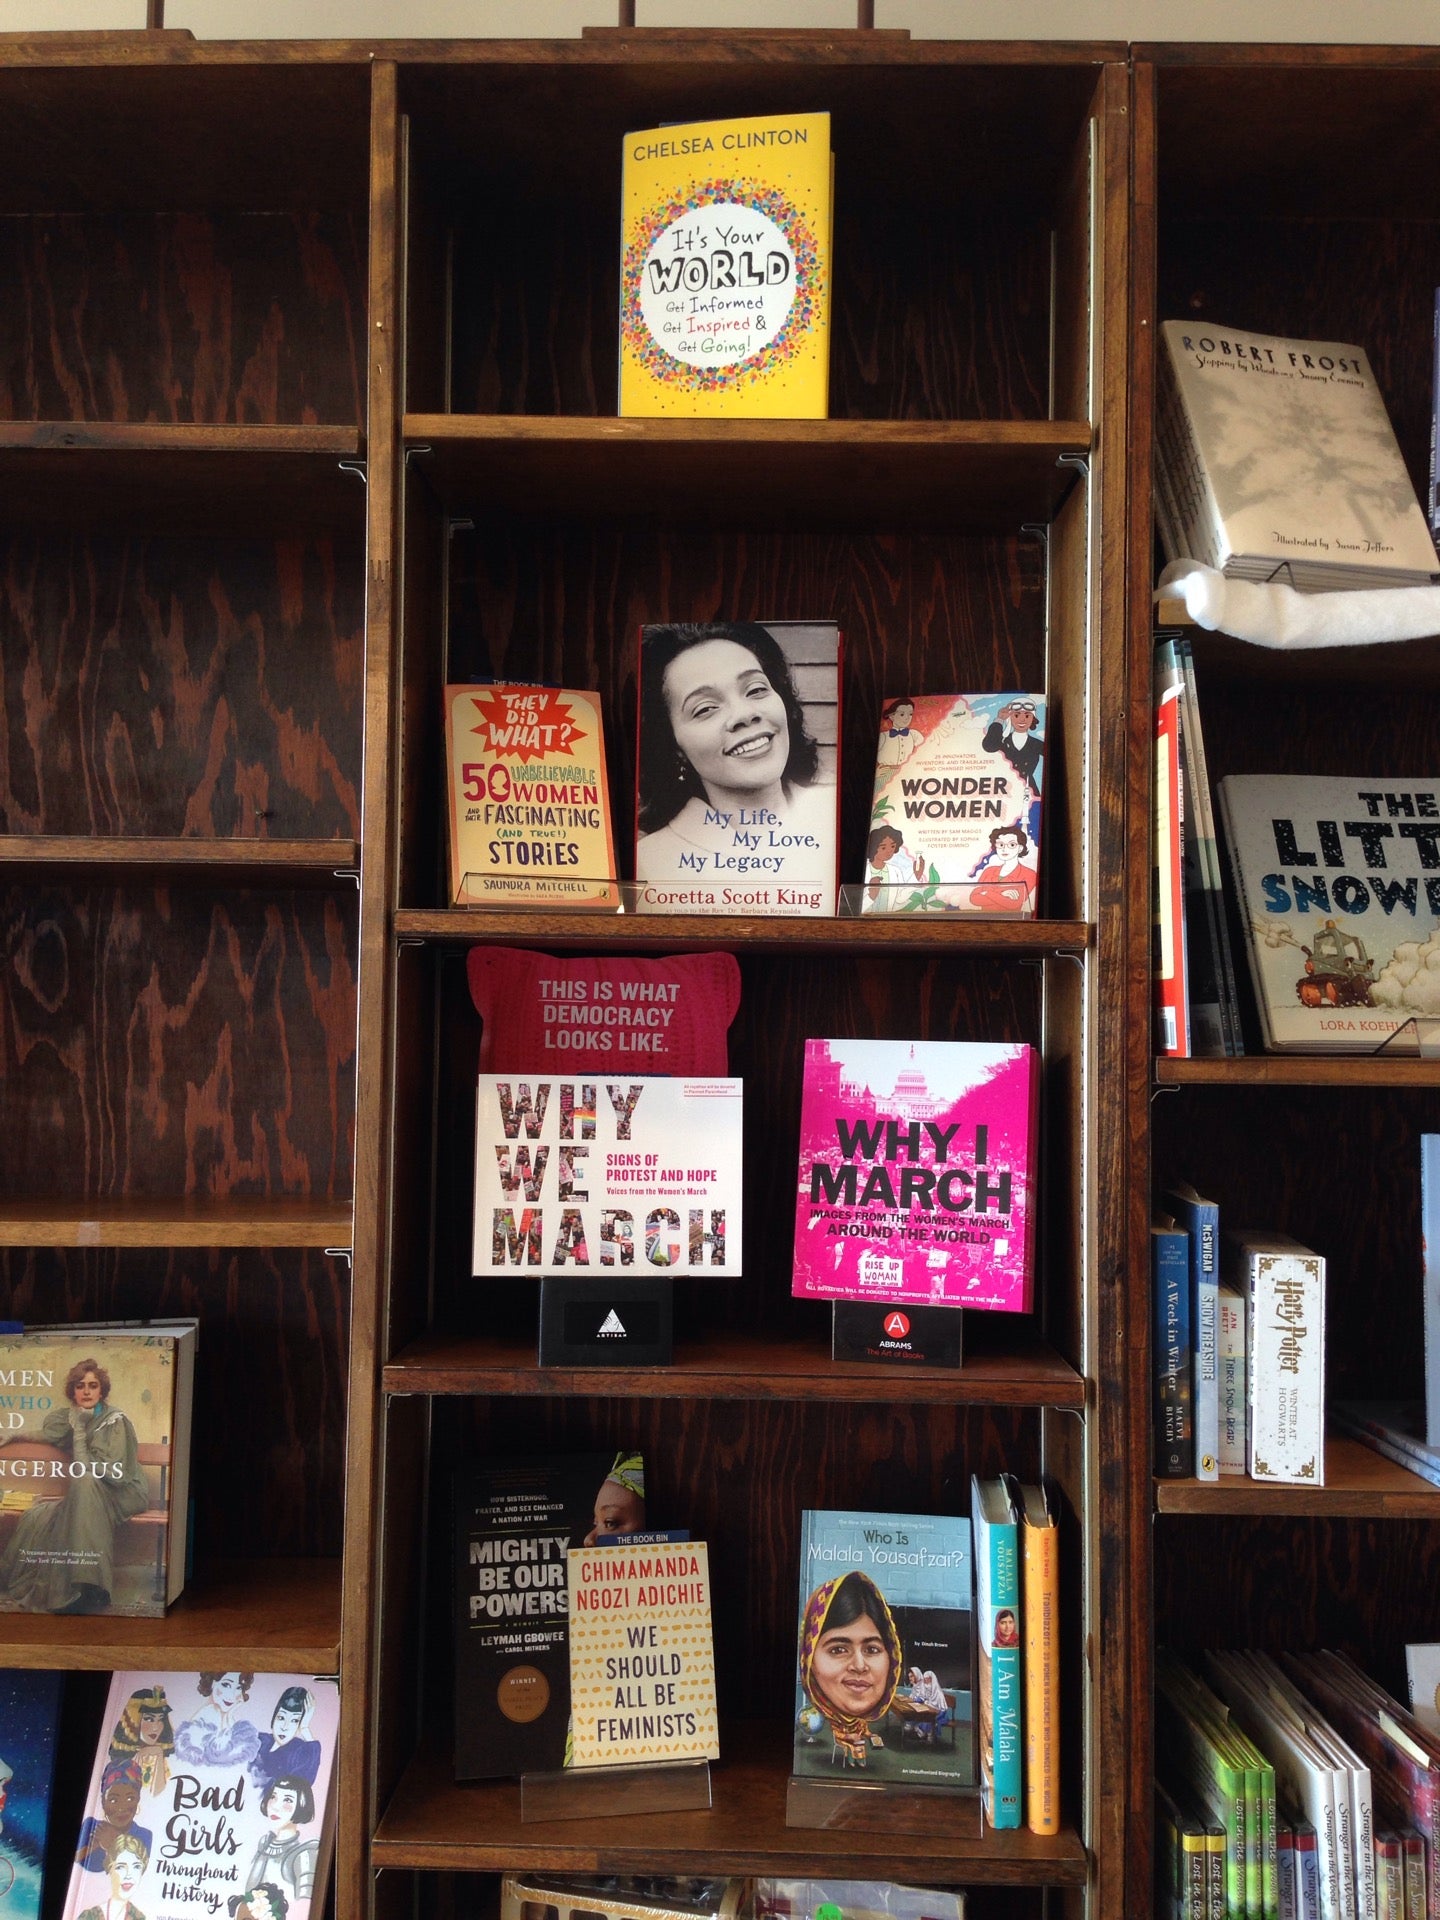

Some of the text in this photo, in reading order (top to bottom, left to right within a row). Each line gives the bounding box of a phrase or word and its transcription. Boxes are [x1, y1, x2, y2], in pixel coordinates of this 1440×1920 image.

[633, 128, 808, 161] CHELSEA CLINTON
[672, 225, 764, 252] It's Your
[648, 250, 790, 294] WORLD
[666, 296, 764, 313] Get Informed
[663, 315, 767, 336] Get Inspired &
[678, 337, 751, 358] Get Going!
[1182, 336, 1362, 375] ROBERT FROST
[501, 693, 549, 711] THEY
[489, 722, 572, 749] WHAT?
[462, 763, 511, 803] 50
[512, 783, 598, 805] WOMEN
[901, 777, 1008, 796] WONDER
[903, 800, 1002, 819] WOMEN
[1358, 792, 1440, 818] THE
[704, 808, 783, 829] My Life,
[732, 830, 821, 850] My Love,
[678, 852, 785, 873] My Legacy
[483, 880, 531, 891] SAUNDRA
[644, 888, 823, 909] Coretta Scott King
[539, 980, 681, 1002] THIS IS WHAT
[543, 1005, 674, 1027] DEMOCRACY
[1320, 1020, 1356, 1031] LORA
[545, 1030, 669, 1052] LOOKS LIKE.
[496, 1083, 645, 1140] WHY
[836, 1119, 988, 1165] WHY I
[606, 1154, 659, 1166] SIGNS OF
[494, 1145, 590, 1202] WE
[606, 1169, 717, 1181] PROTEST AND HOPE
[606, 1187, 628, 1195] Voices
[629, 1187, 645, 1195] from
[657, 1187, 686, 1195] Women's
[810, 1163, 1012, 1214] MARCH
[810, 1208, 1010, 1229] IMAGES FROM THE WOMEN'S MARCH
[492, 1208, 726, 1266] MARCH
[826, 1223, 991, 1244] AROUND THE WORLD
[1202, 1224, 1213, 1272] McSWIGAN
[864, 1271, 897, 1281] WOMAN
[865, 1261, 900, 1270] RISE UP
[1167, 1280, 1179, 1392] A Week in Winter
[1201, 1295, 1215, 1380] SNOW TREASURE
[1268, 1278, 1307, 1375] Harry Potter
[879, 1341, 912, 1350] ABRAMS
[1226, 1357, 1236, 1383] THREE
[0, 1396, 53, 1410] WHO
[1226, 1386, 1236, 1414] SNOW
[0, 1412, 25, 1429] D
[1165, 1406, 1174, 1443] BINCHY
[1278, 1387, 1287, 1447] HOGWARTS
[1288, 1388, 1298, 1440] WINTER AT
[1226, 1417, 1236, 1445] BEARS
[469, 1536, 571, 1564] MIGHTY
[617, 1533, 669, 1544] THE BOOK BIN
[863, 1530, 909, 1545] Who Is
[808, 1543, 963, 1567] Malala Yousafzai?
[479, 1564, 564, 1591] BE OUR
[581, 1556, 700, 1583] CHIMAMANDA
[996, 1540, 1006, 1600] YOUSAFZAI
[1005, 1548, 1013, 1592] MALALA
[469, 1590, 570, 1619] POWERS
[577, 1582, 705, 1611] NGOZI ADICHIE
[481, 1631, 565, 1646] LEYMAH GBOWEE
[627, 1626, 658, 1649] WE
[606, 1654, 682, 1680] SHOULD
[510, 1677, 537, 1685] WINNER
[998, 1669, 1015, 1700] Am
[615, 1683, 676, 1709] ALL BE
[597, 1713, 697, 1742] FEMINISTS
[996, 1705, 1018, 1762] Malala
[909, 1768, 938, 1776] Unauthorized
[938, 1769, 961, 1777] Biography
[170, 1774, 245, 1812] Bad
[160, 1813, 243, 1858] Girls
[1339, 1802, 1349, 1851] Stranger
[1193, 1856, 1202, 1879] Lost
[1343, 1852, 1350, 1863] in
[1360, 1802, 1375, 1917] Stranger in the Woods
[156, 1860, 239, 1886] Throughout
[162, 1882, 224, 1915] History
[1193, 1883, 1202, 1897] in
[1344, 1881, 1353, 1917] Woods
